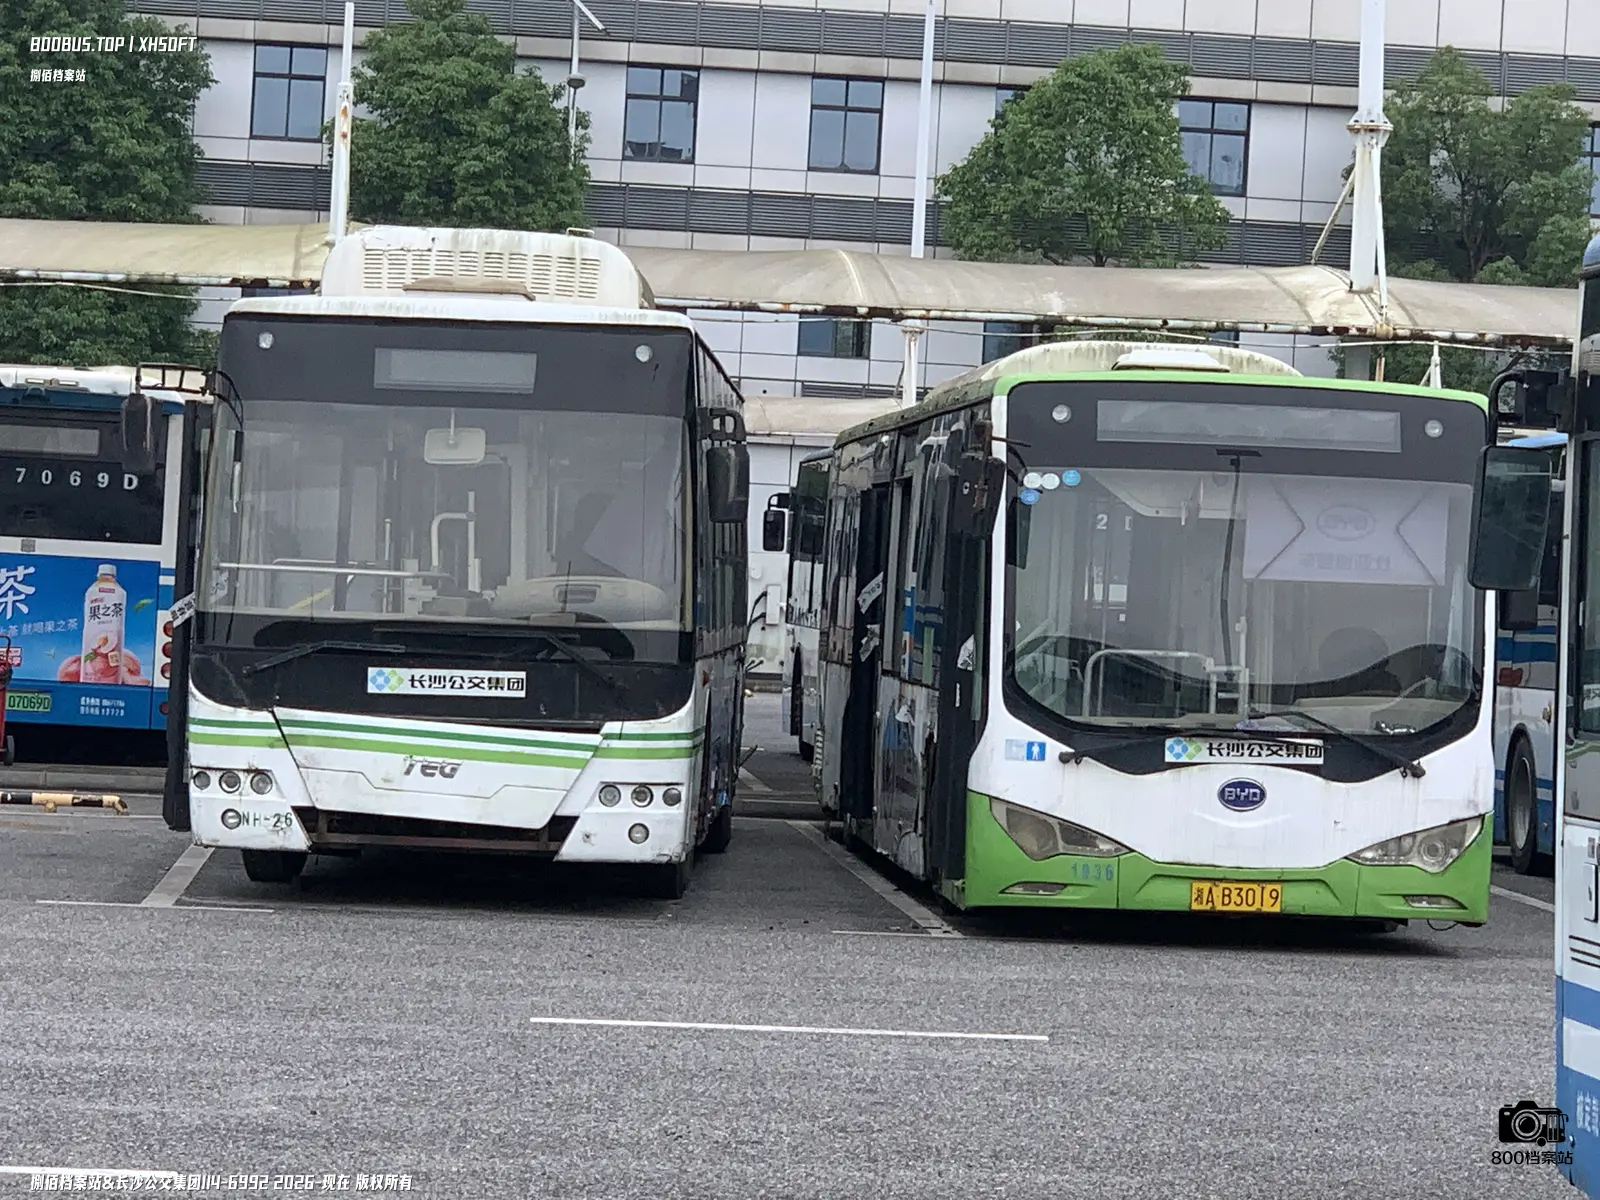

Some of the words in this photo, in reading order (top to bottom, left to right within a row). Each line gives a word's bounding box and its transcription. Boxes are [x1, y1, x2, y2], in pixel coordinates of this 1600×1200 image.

[0, 565, 36, 620] 茶
[88, 602, 123, 622] 果之茶
[408, 674, 524, 691] 长沙公交集团
[1206, 742, 1323, 759] 长沙公交集团
[1224, 787, 1261, 801] BYD
